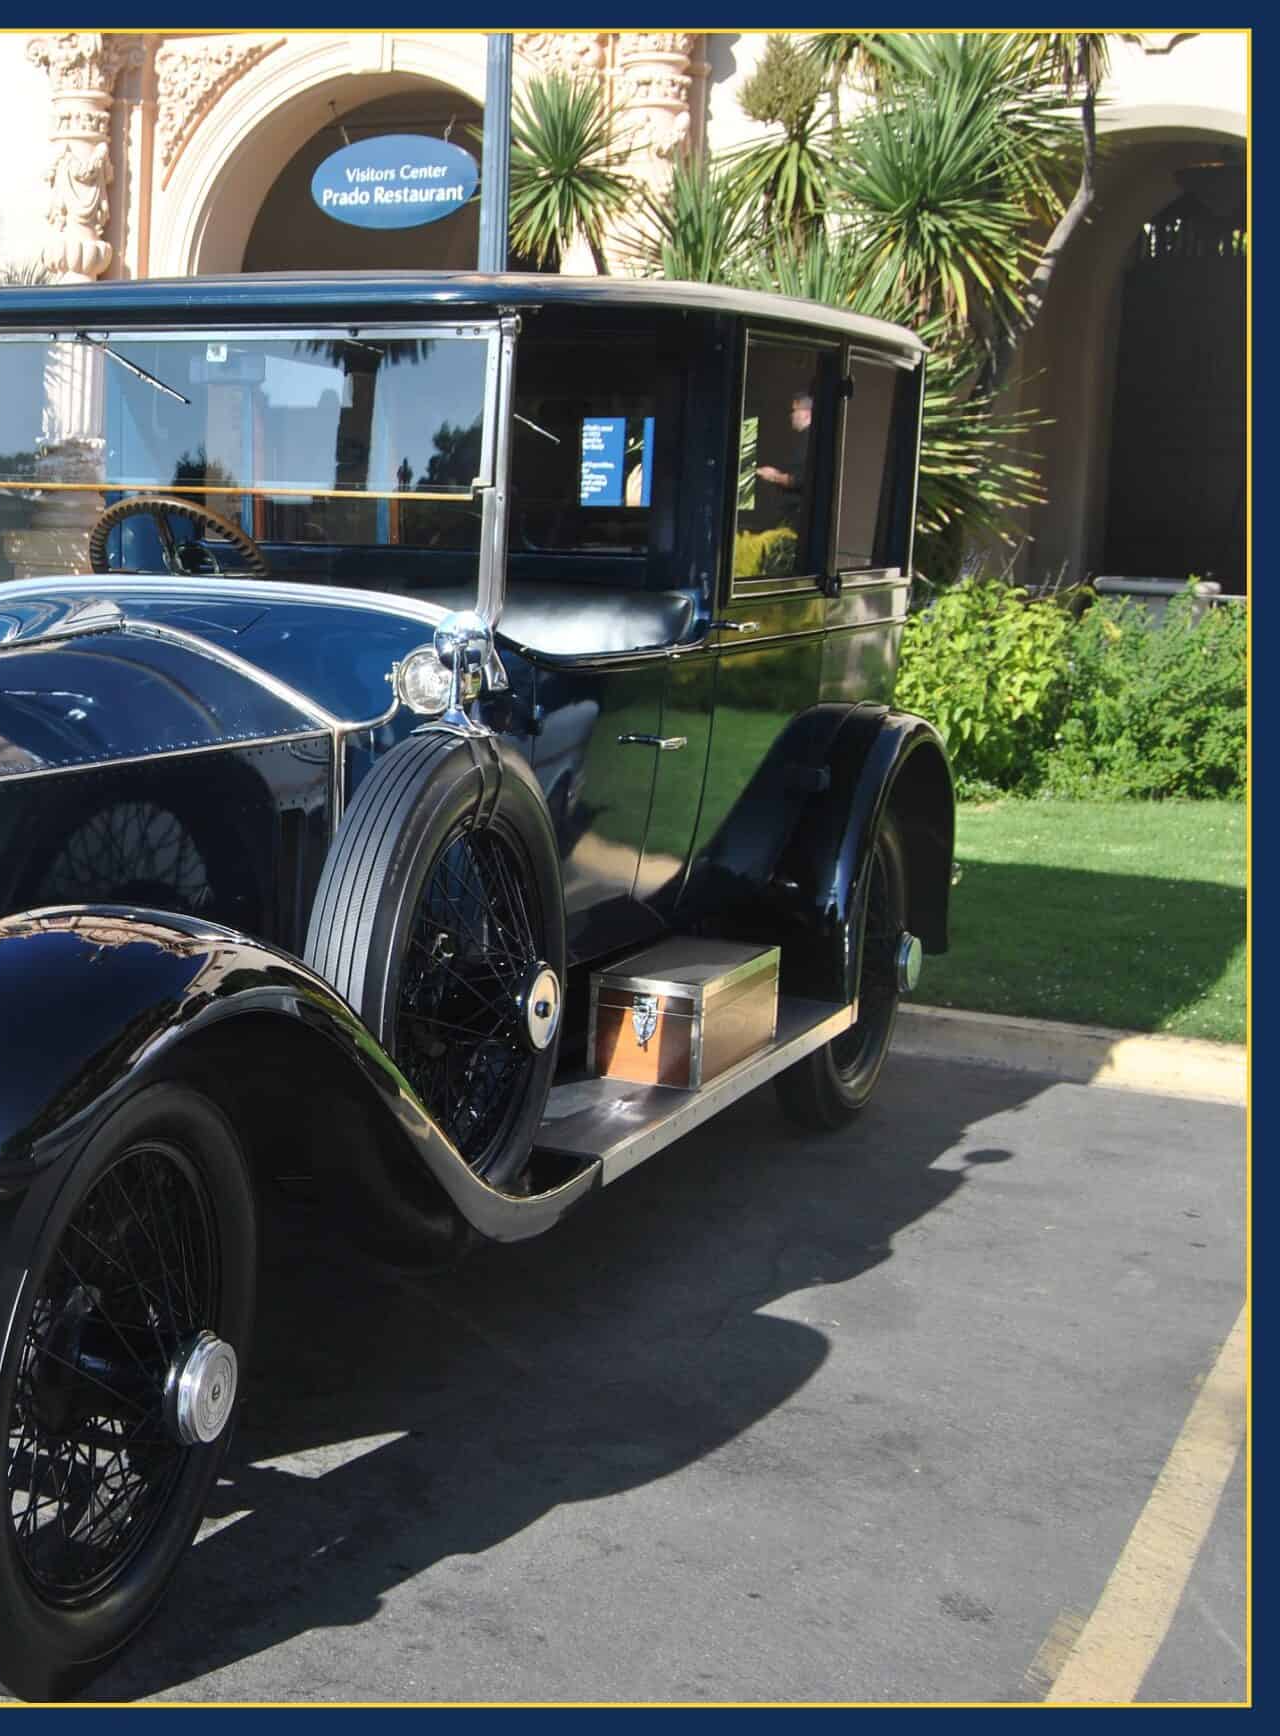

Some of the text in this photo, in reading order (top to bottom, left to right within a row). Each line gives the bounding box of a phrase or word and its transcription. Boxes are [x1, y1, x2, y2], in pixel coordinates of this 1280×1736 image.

[346, 164, 448, 183] Visitors Center
[322, 184, 464, 206] Prado Restaurant
